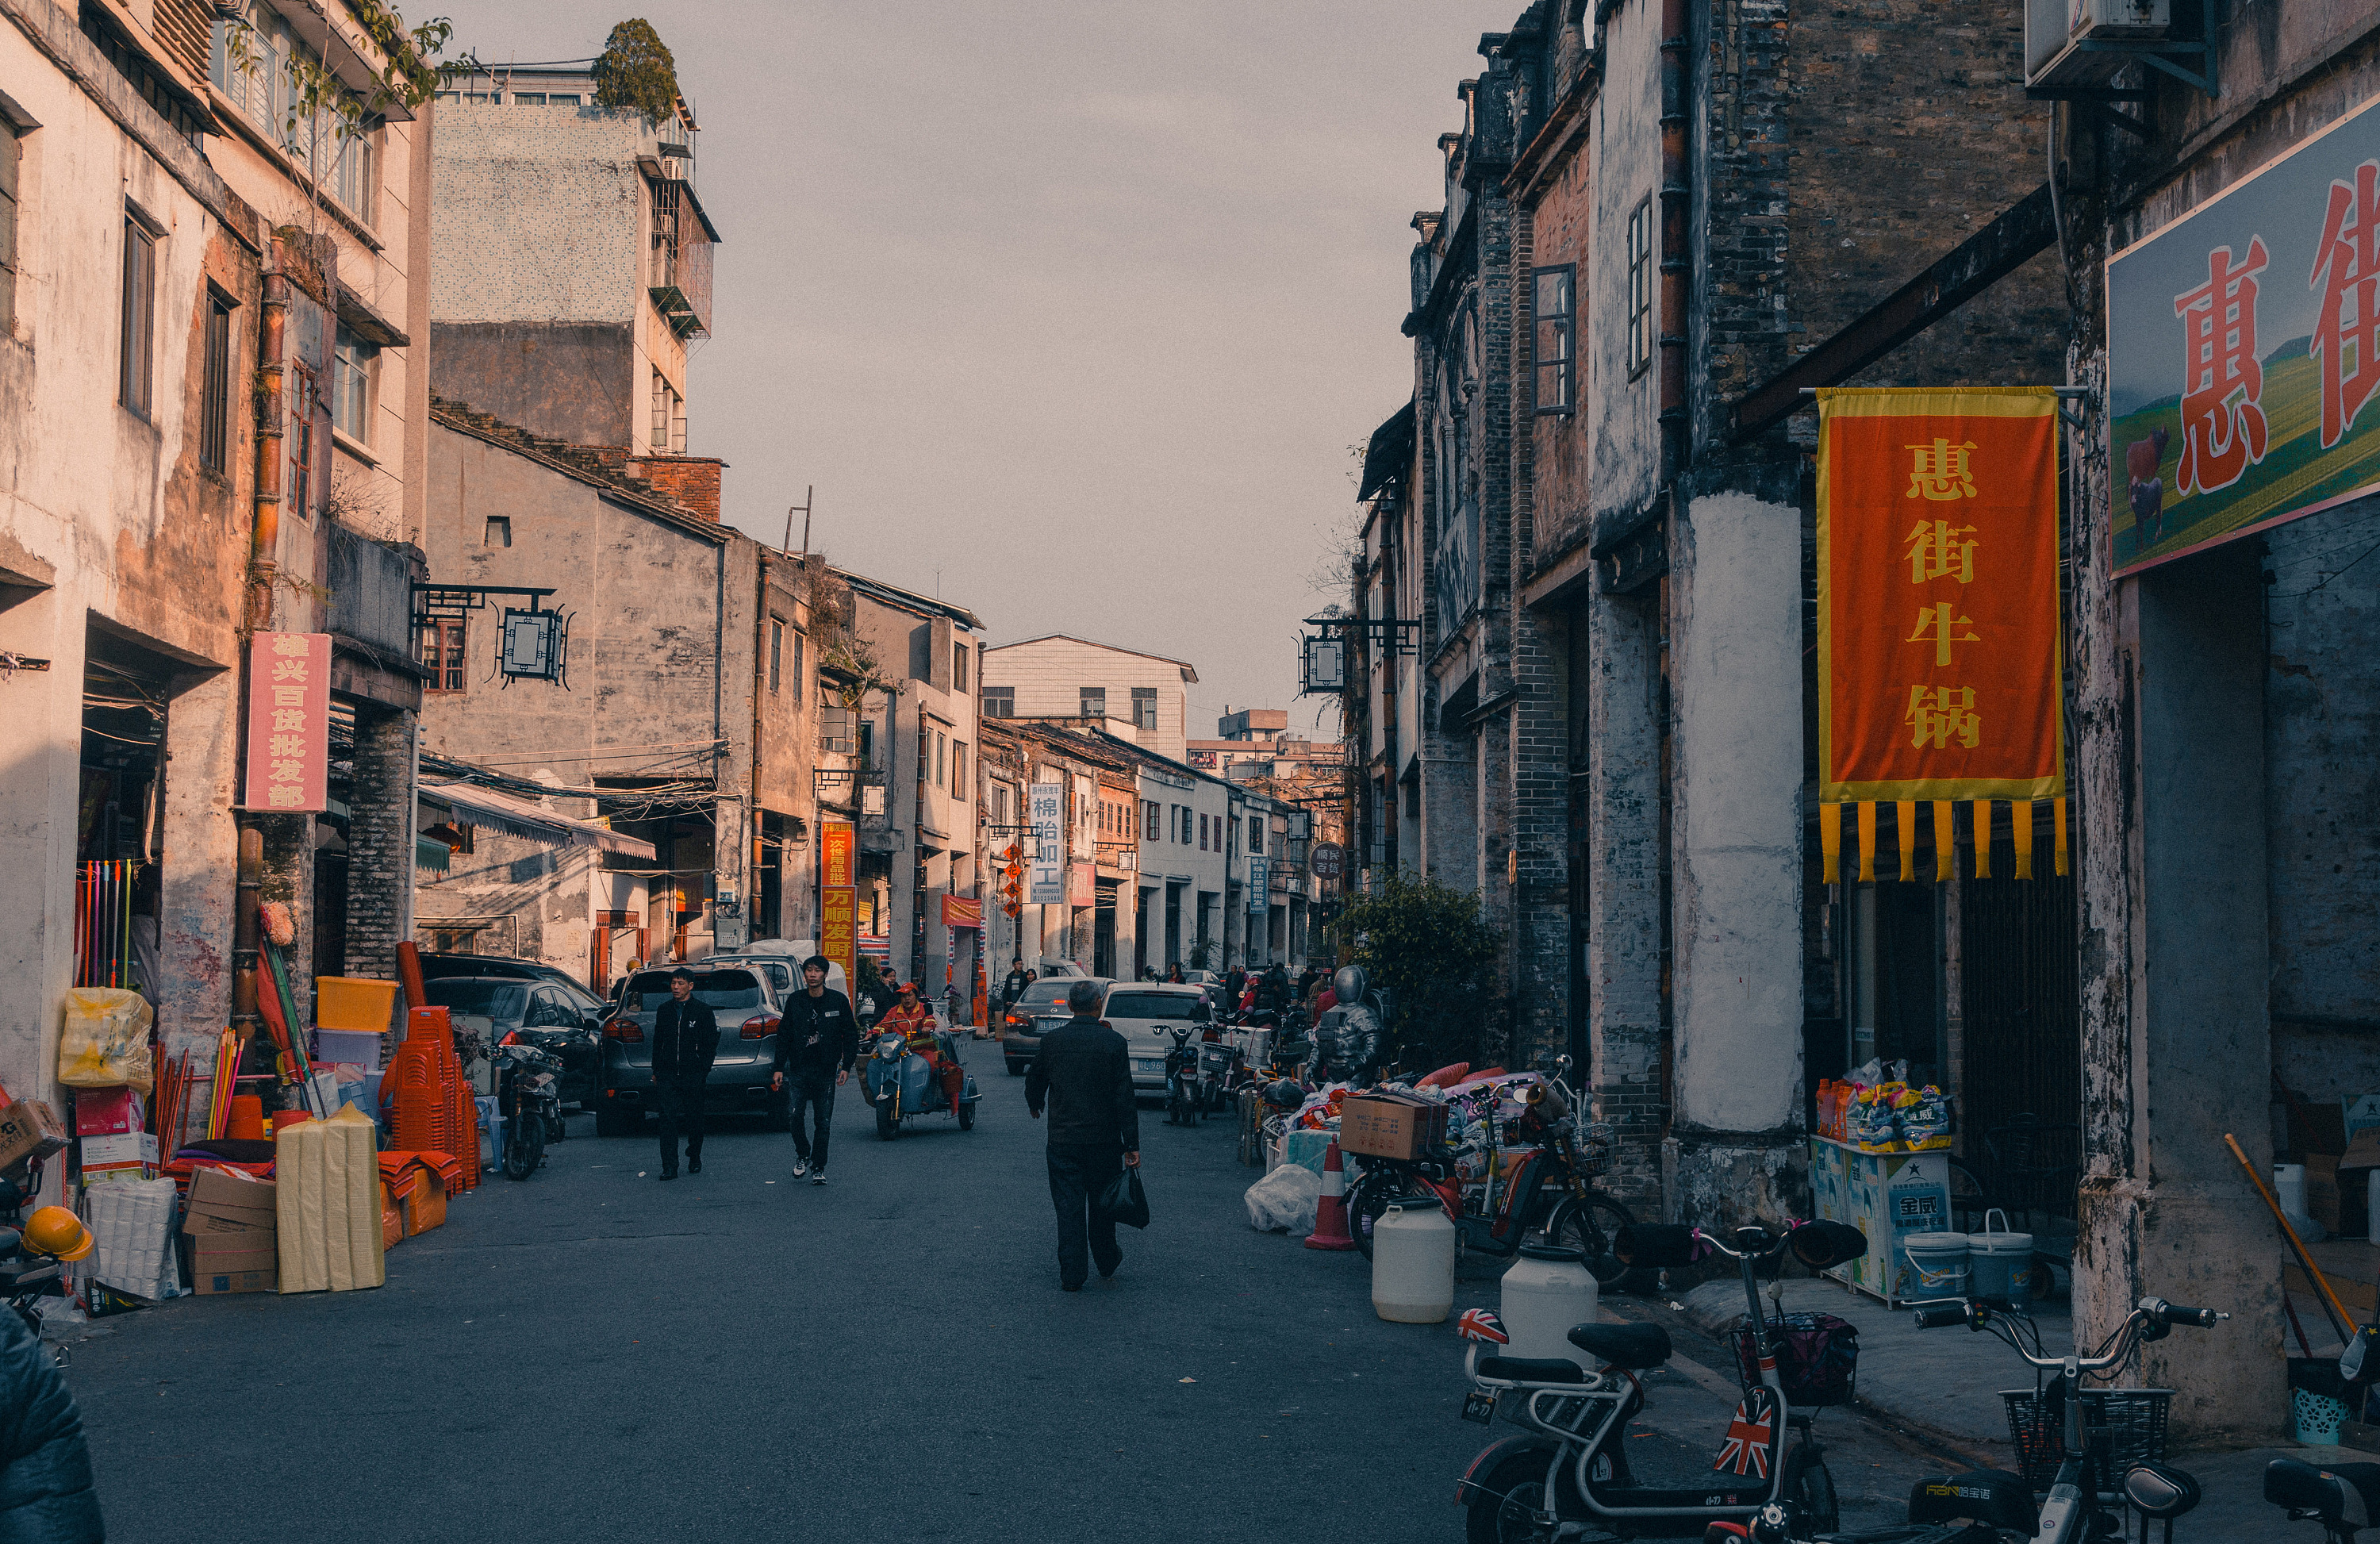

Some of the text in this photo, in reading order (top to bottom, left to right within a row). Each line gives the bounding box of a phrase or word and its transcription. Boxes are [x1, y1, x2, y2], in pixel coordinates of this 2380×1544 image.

[1904, 437, 1981, 750] 惠街牛锅
[268, 634, 309, 808] 雄兴百货批发部
[1032, 786, 1059, 795] 惠州永茂丰
[823, 824, 852, 832] 万顺发厨具
[1035, 797, 1059, 885] 棉胎加工
[1253, 866, 1265, 906] 珠江塑胶批发
[1899, 1195, 1937, 1216] 金威
[1959, 1486, 1990, 1500] 哈宝诺
